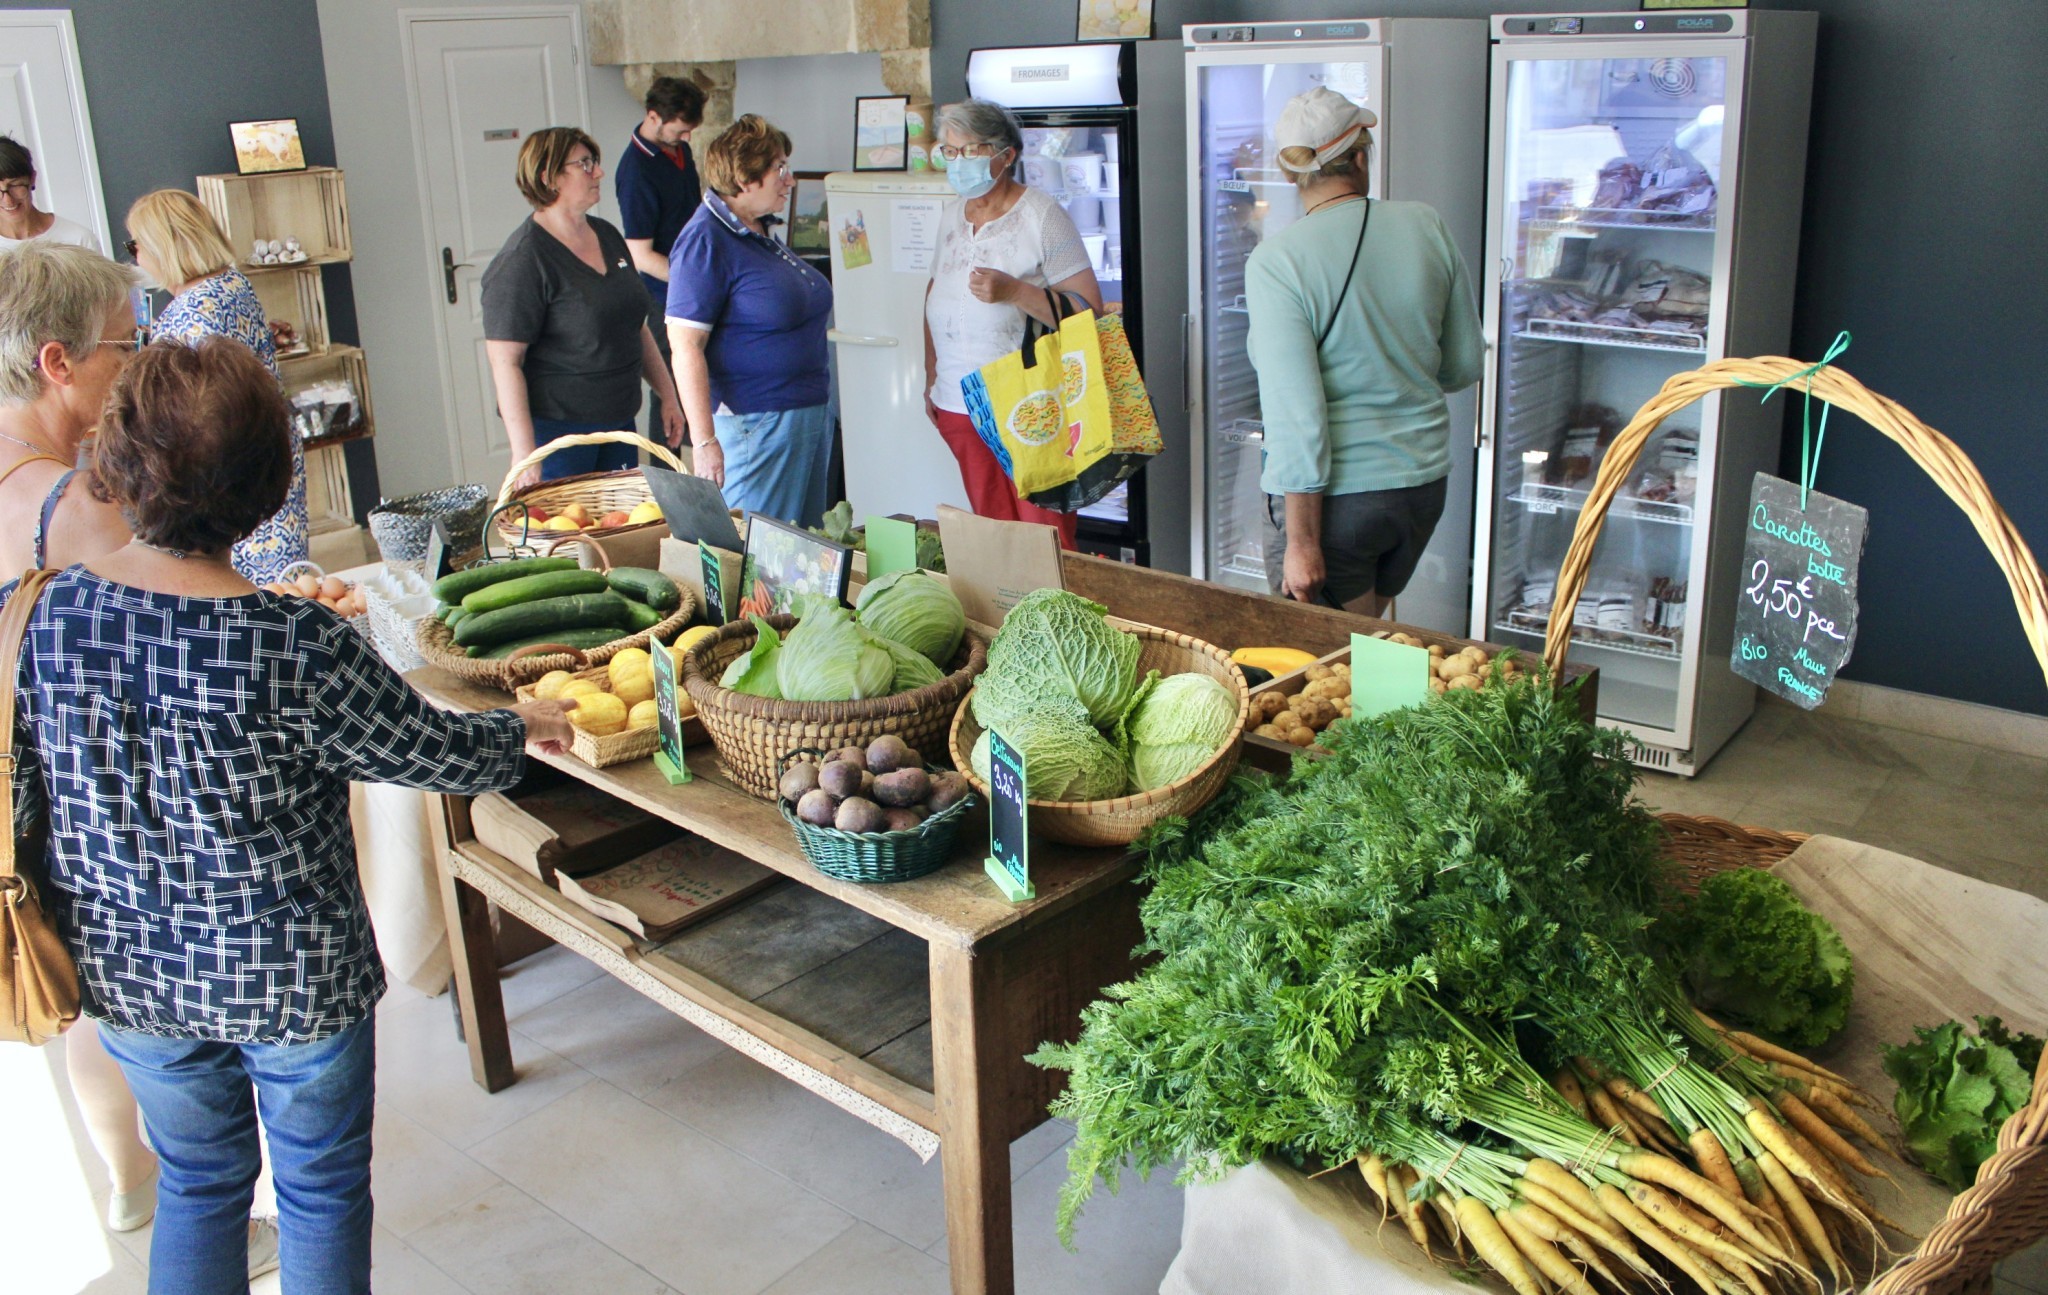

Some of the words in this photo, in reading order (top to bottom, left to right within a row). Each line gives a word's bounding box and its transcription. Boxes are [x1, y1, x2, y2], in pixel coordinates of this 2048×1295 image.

[1677, 18, 1713, 26] POLAR
[1018, 69, 1061, 79] FROMAGES
[1529, 502, 1554, 512] PORC
[1753, 504, 1832, 557] Carottes
[1808, 553, 1846, 586] botte
[1803, 610, 1846, 643] pce
